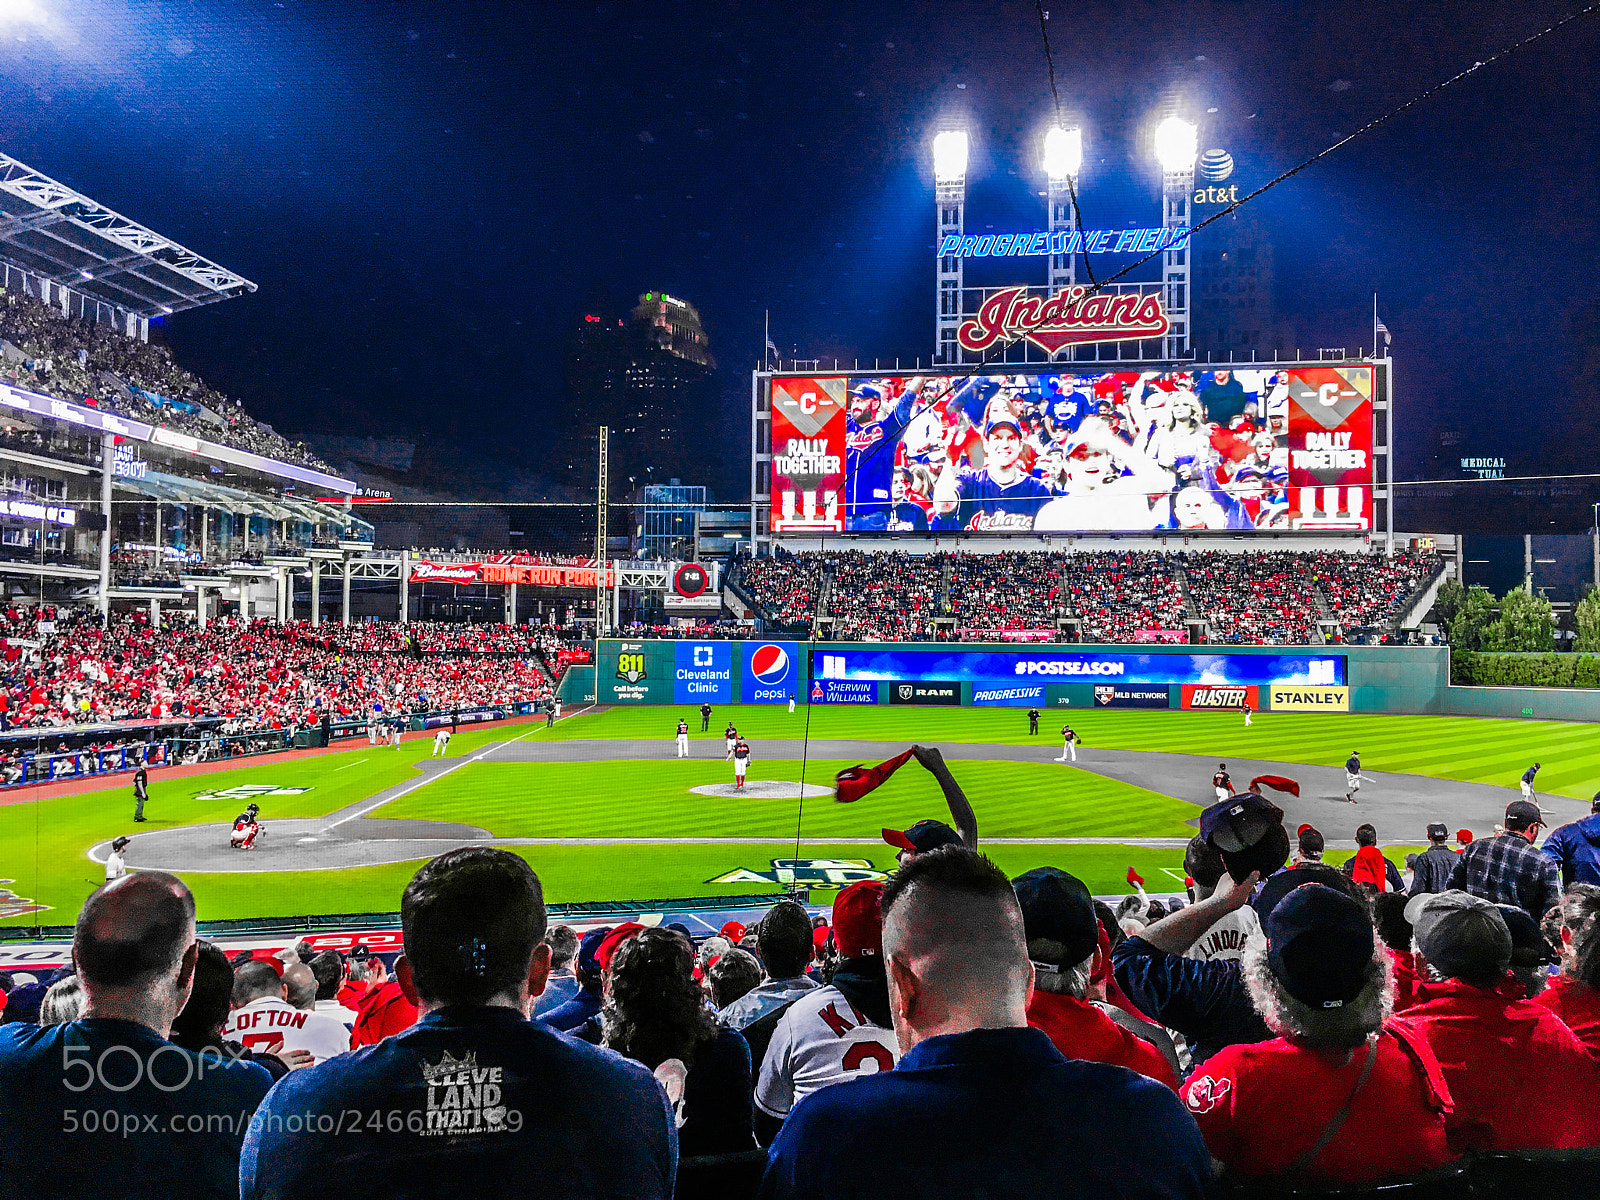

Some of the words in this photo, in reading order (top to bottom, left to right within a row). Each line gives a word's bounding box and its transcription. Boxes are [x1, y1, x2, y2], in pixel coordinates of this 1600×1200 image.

[1194, 184, 1238, 203] at&t
[937, 229, 1113, 258] PROGRESSIVE
[1114, 226, 1192, 252] FIELD
[957, 285, 1171, 357] Indians
[788, 438, 829, 456] RALLY
[1305, 432, 1352, 450] RALLY
[774, 456, 841, 474] TOGETHER
[1460, 457, 1506, 468] MEDICAL
[365, 488, 391, 497] Arena
[414, 562, 477, 579] Budweiser
[483, 567, 527, 584] HOME
[530, 568, 562, 585] RUN
[564, 570, 614, 588] PORH
[618, 653, 644, 673] 811
[1015, 660, 1124, 675] #POSTSEASON
[676, 668, 730, 680] Cleveland
[687, 682, 719, 693] Clinic
[754, 688, 786, 700] pepsi
[827, 681, 871, 692] SHERWIN
[915, 689, 953, 697] RAM
[974, 686, 1042, 702] PROGRESSIVE
[1057, 697, 1070, 705] 370
[1114, 691, 1130, 699] MLB
[1191, 689, 1247, 707] BLASTER
[1274, 692, 1344, 705] STANLEY
[1521, 707, 1534, 715] 400
[426, 1083, 502, 1111] LAND
[426, 1109, 472, 1129] THAT
